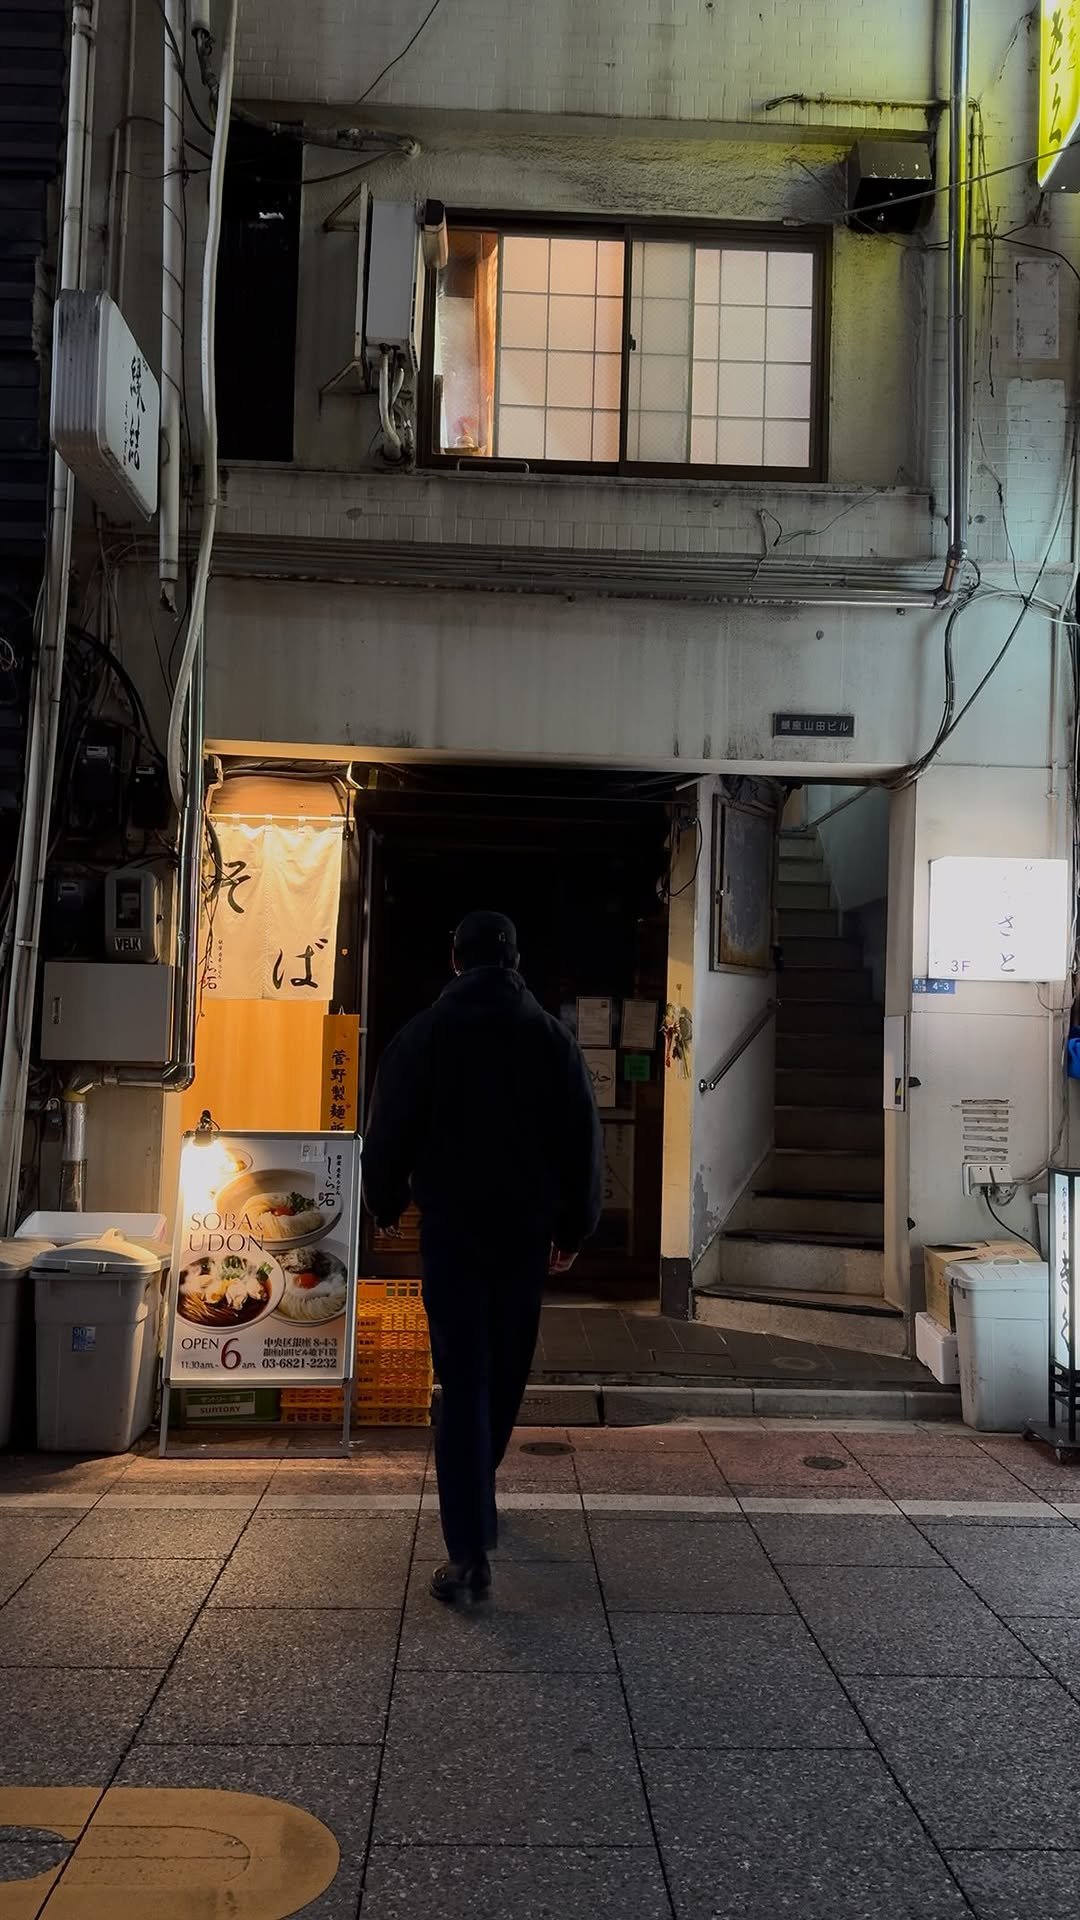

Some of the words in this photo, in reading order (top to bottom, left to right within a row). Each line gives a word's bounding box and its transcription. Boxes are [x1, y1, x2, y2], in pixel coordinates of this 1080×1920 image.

[781, 720, 849, 732] 銀座山田ビル
[950, 959, 971, 973] 3F
[932, 981, 950, 992] 4-3
[318, 1156, 336, 1207] しら石
[190, 1212, 253, 1231] SOBA
[189, 1233, 264, 1252] UDON
[181, 1337, 219, 1350] OPEN
[264, 1337, 311, 1347] 中央区銀座
[313, 1337, 338, 1347] 8-4-3
[221, 1337, 241, 1370] 6
[262, 1358, 337, 1368] 03-6821-2232
